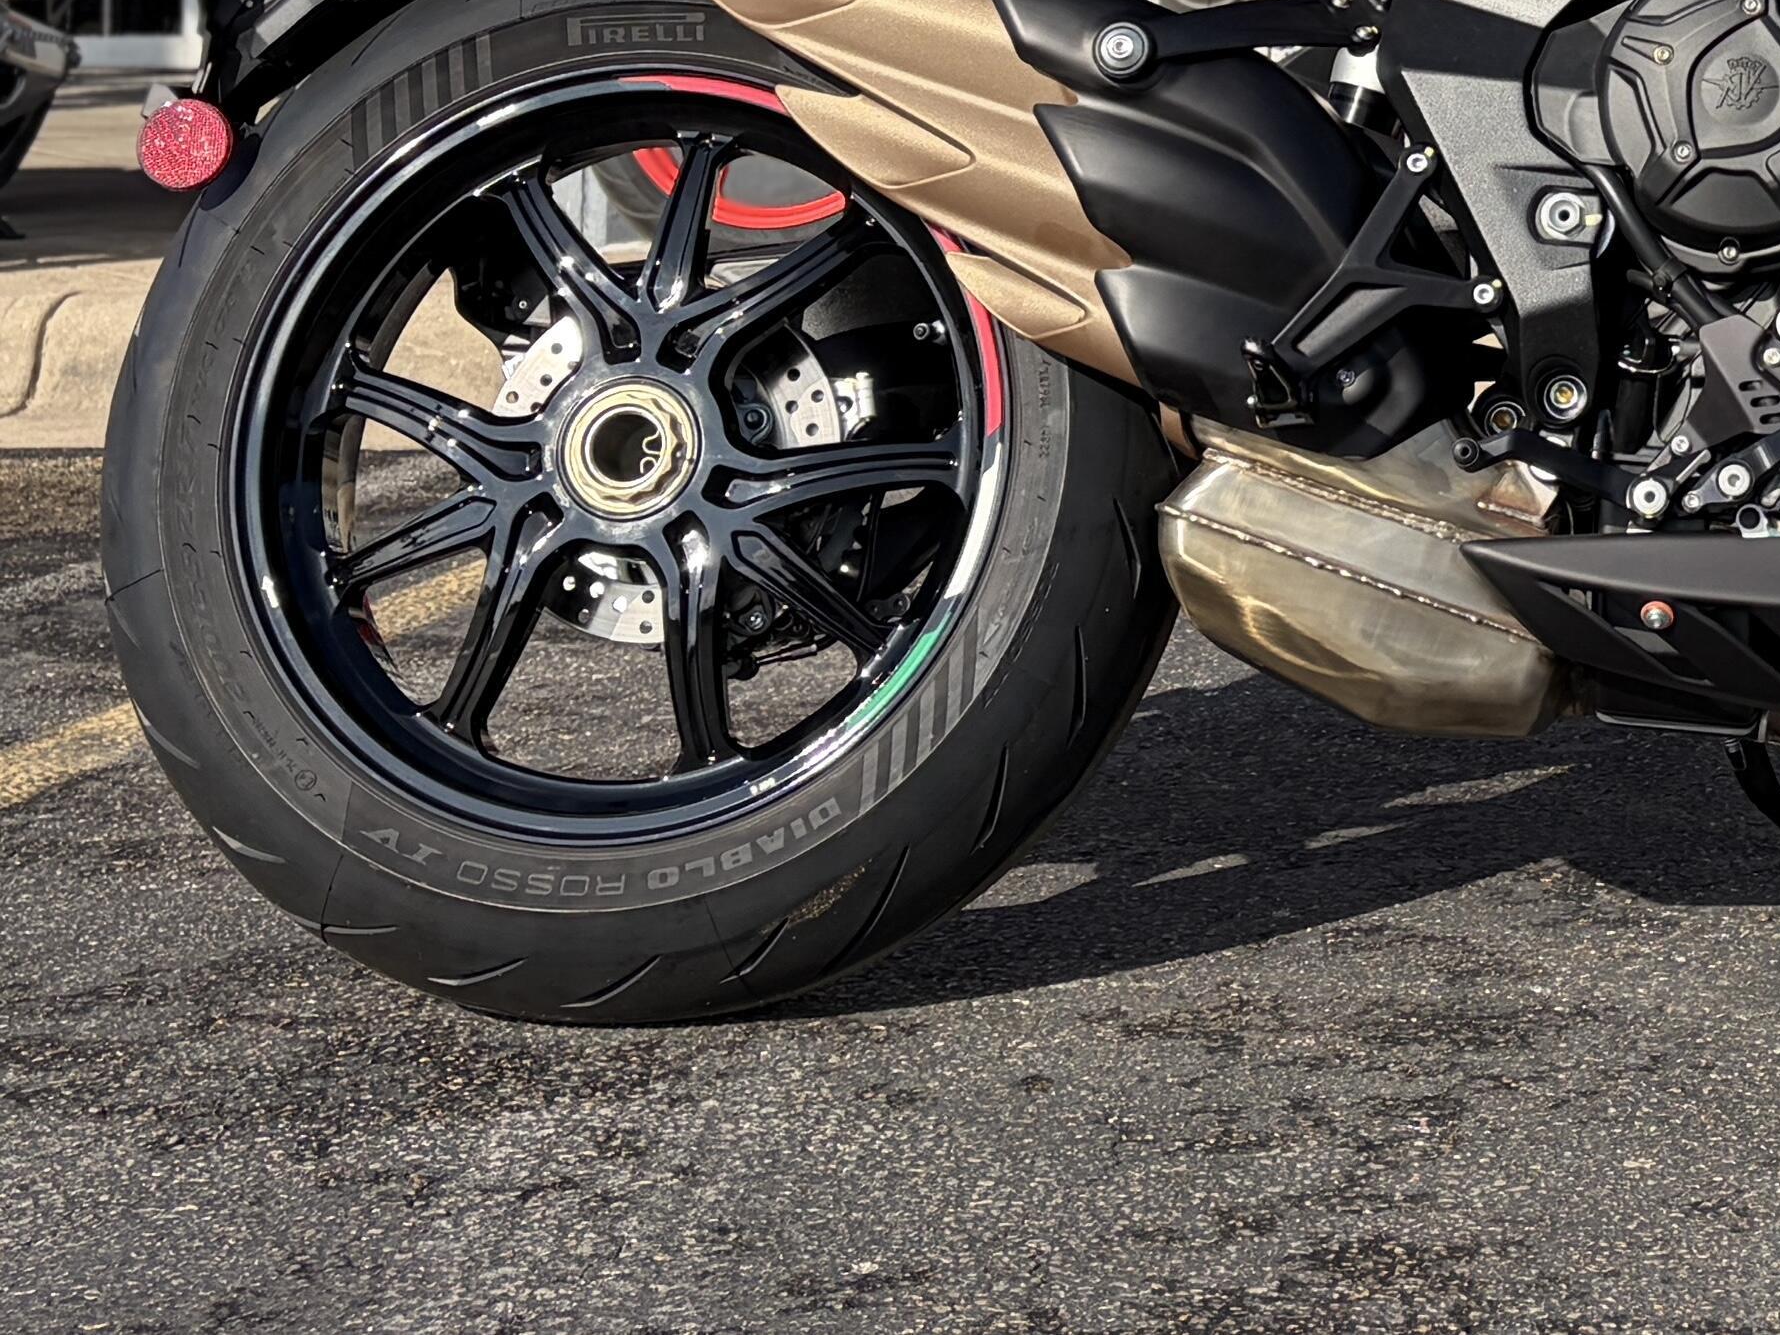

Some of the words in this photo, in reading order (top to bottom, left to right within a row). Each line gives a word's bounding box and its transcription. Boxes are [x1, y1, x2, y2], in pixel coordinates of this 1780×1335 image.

[566, 12, 706, 47] PIRELLI
[359, 827, 443, 866] IV
[647, 796, 842, 891] DIABLO
[456, 860, 626, 896] ROSSO
